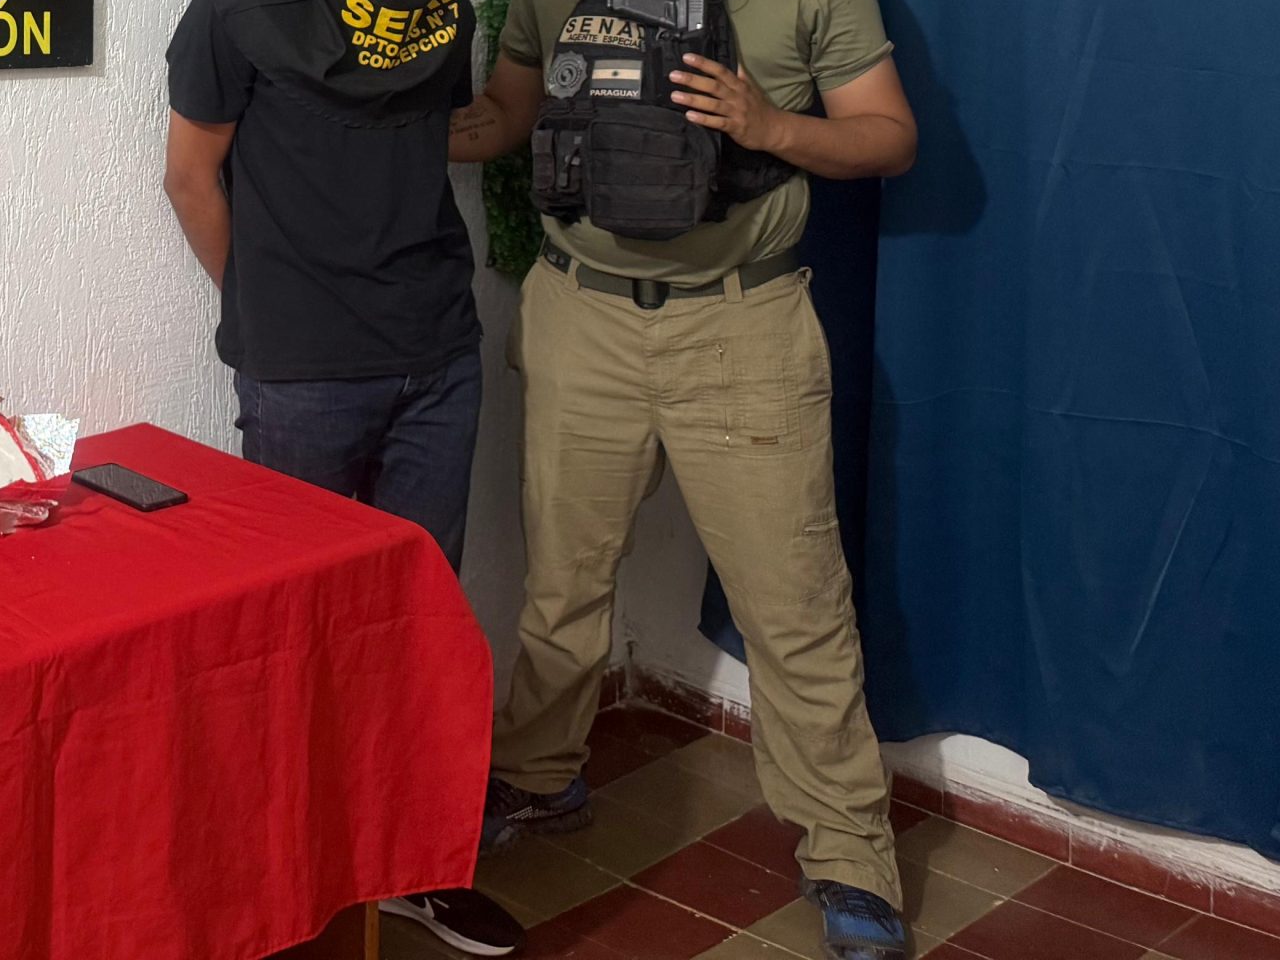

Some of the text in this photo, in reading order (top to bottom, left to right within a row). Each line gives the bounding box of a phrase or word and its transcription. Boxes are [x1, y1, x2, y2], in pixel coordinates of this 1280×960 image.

[448, 2, 459, 19] 7
[568, 33, 598, 42] AGENTE
[358, 23, 457, 69] CONEPCION
[589, 89, 639, 97] PARAGUAY
